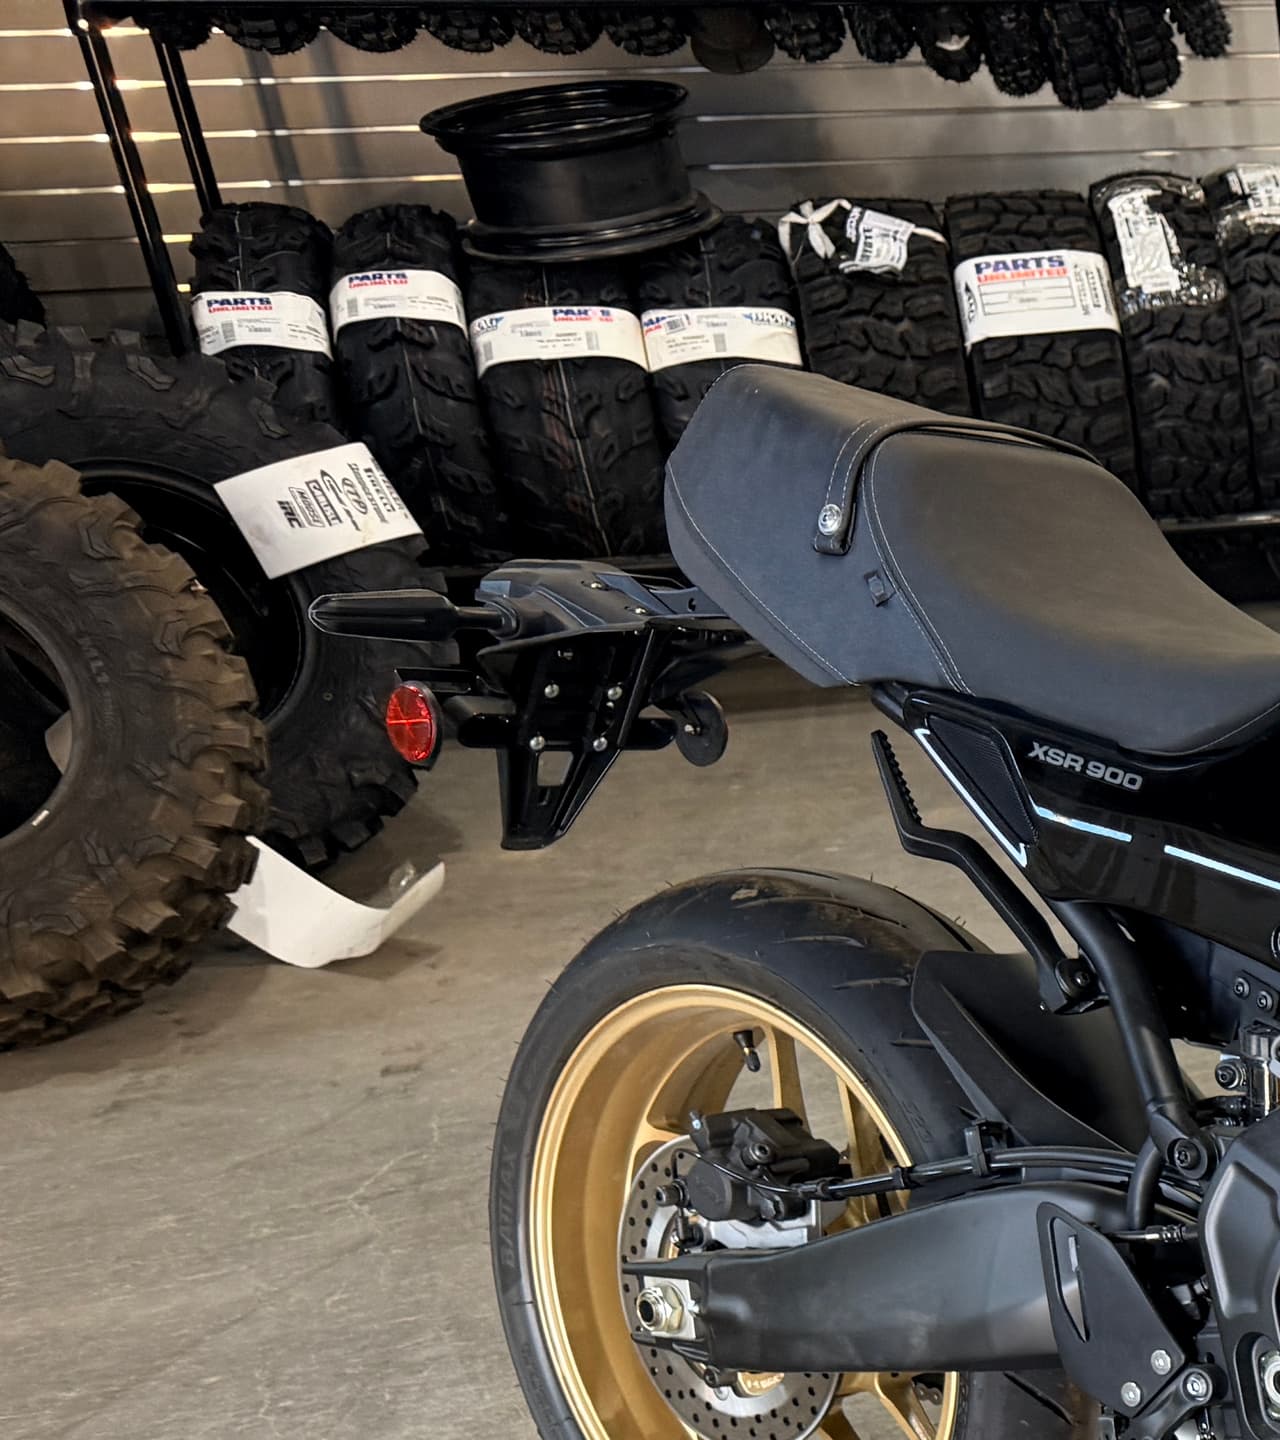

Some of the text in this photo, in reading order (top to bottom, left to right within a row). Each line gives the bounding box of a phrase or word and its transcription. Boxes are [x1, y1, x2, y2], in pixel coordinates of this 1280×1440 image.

[974, 255, 1065, 274] PARTS
[348, 272, 409, 283] PARTS
[977, 267, 1070, 283] UNLIMITED
[206, 296, 272, 307] PARTS
[1027, 741, 1143, 790] XSR 900
